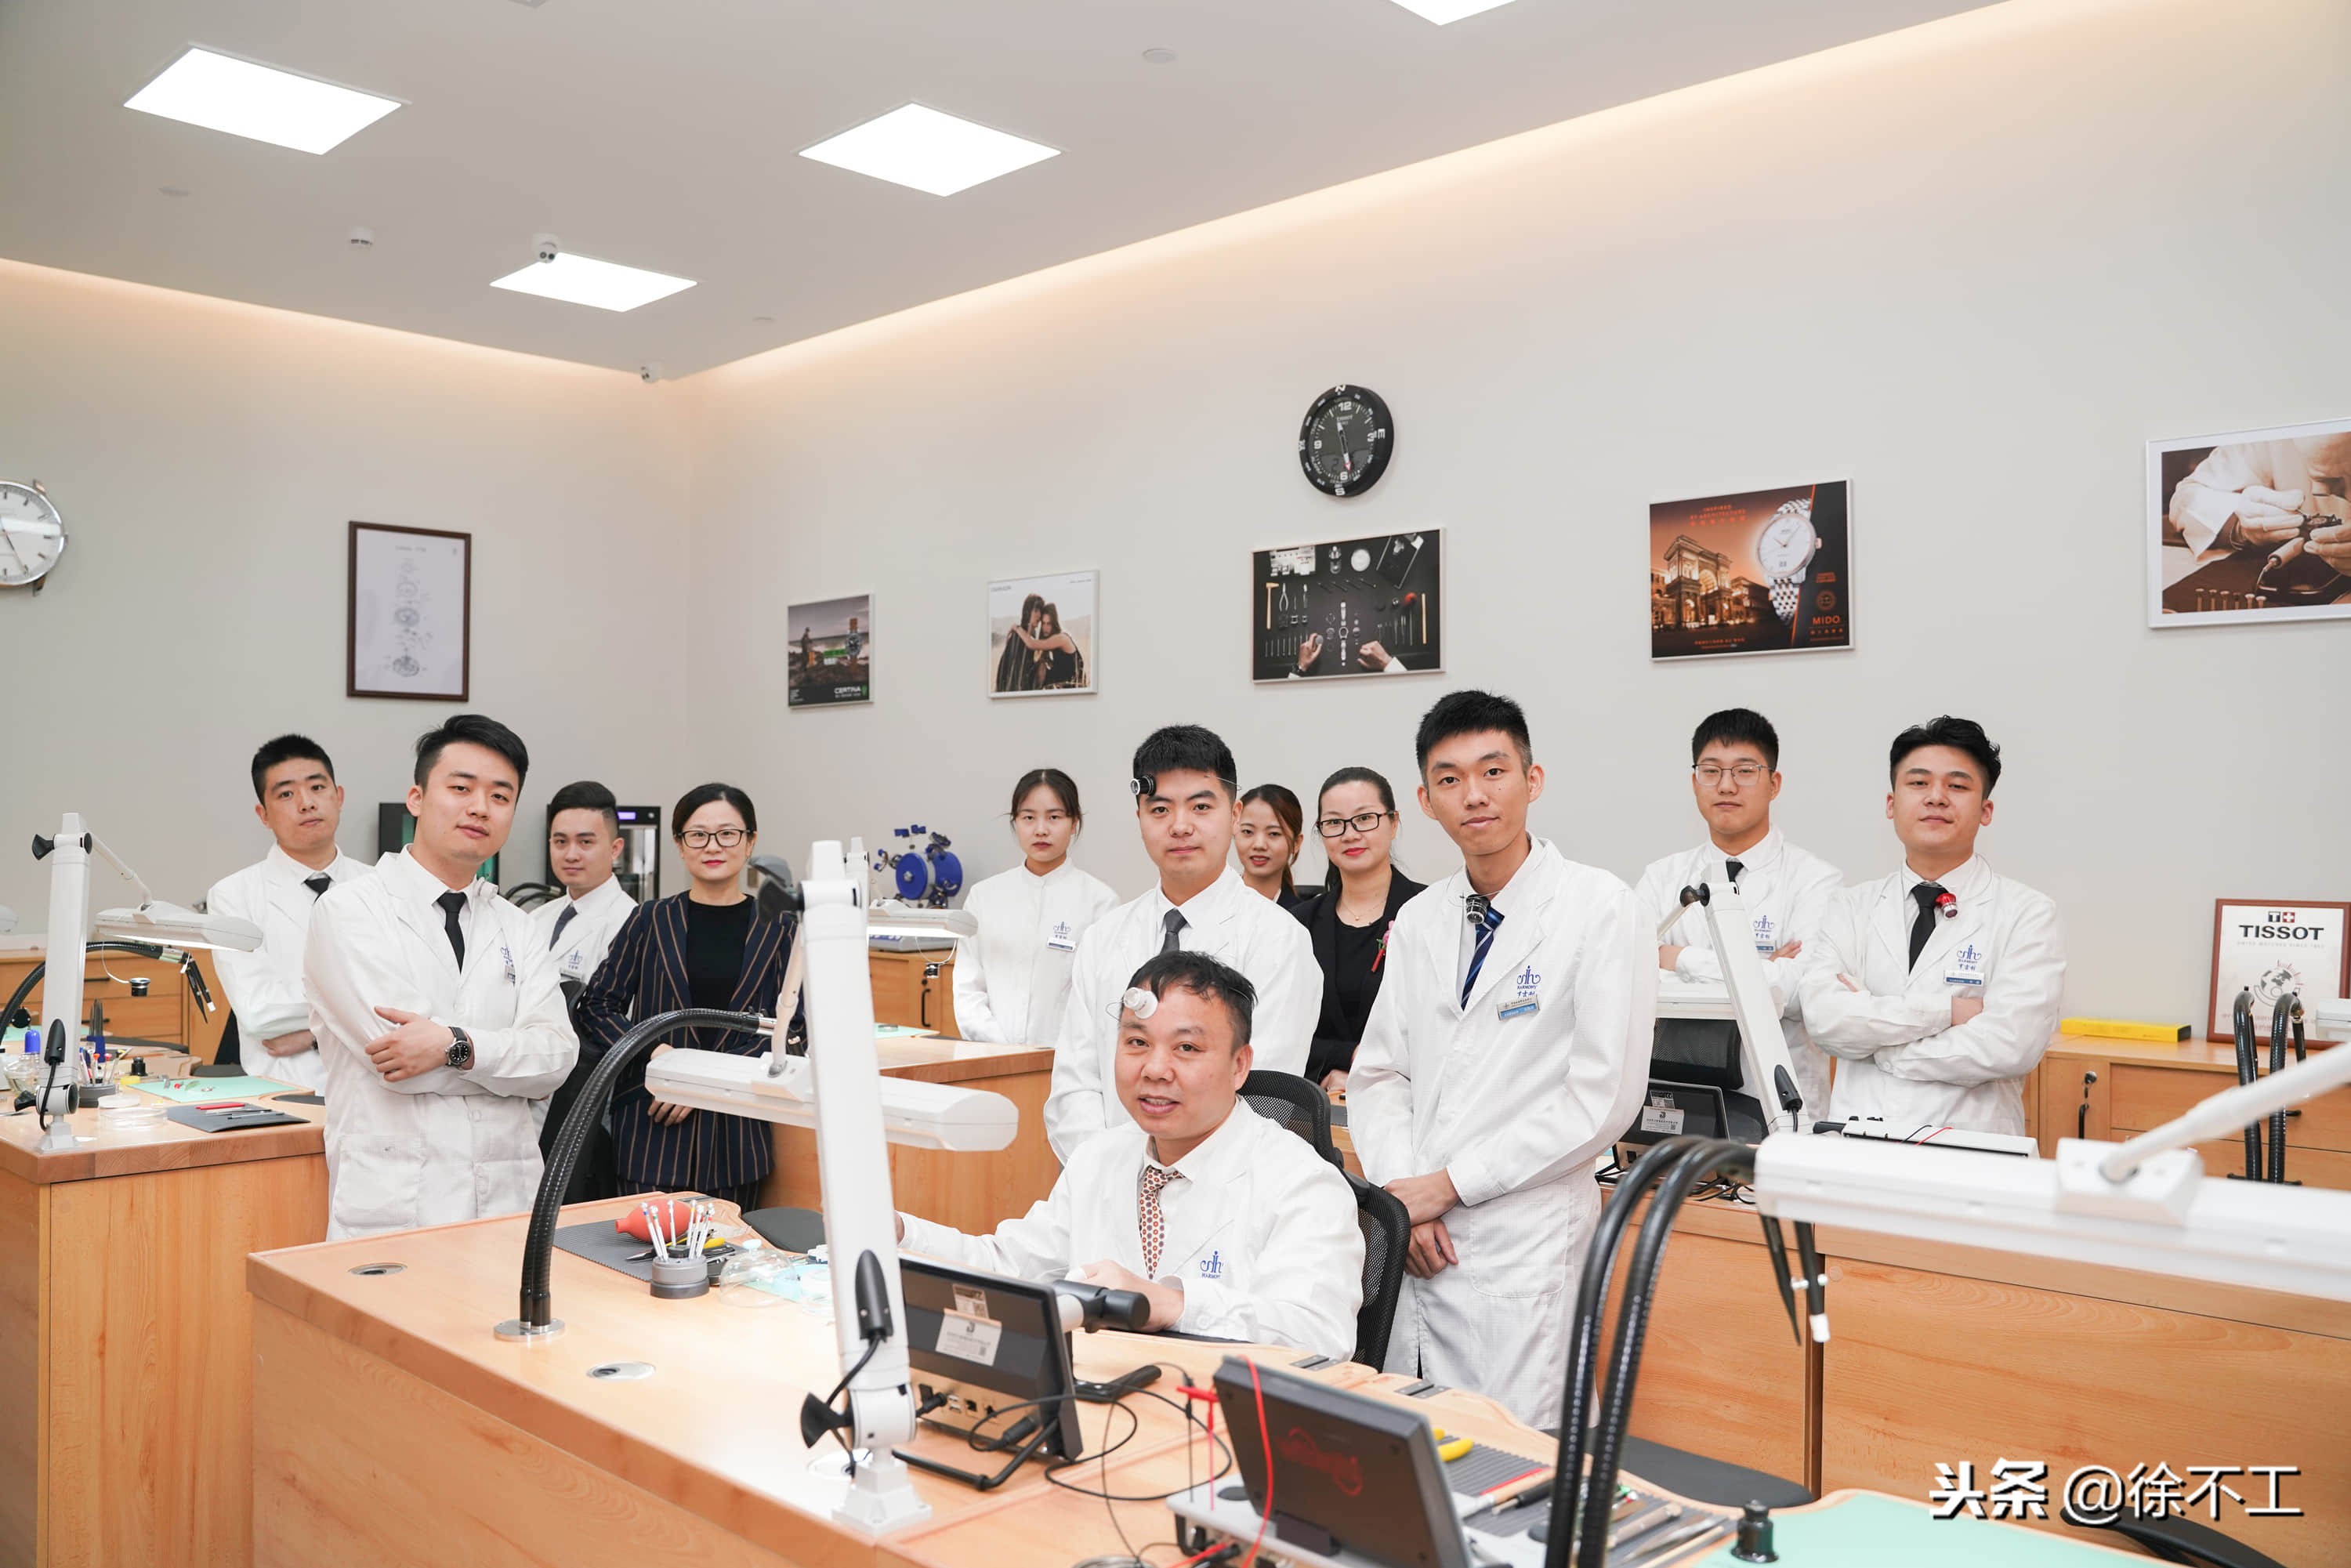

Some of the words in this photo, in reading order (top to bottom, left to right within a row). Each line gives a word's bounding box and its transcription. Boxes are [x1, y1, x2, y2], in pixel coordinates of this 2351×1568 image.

[1338, 401, 1352, 411] 12
[1313, 440, 1322, 449] 9
[1339, 472, 1348, 480] 6
[1812, 615, 1840, 625] MIDO
[2238, 925, 2324, 940] TISSOT
